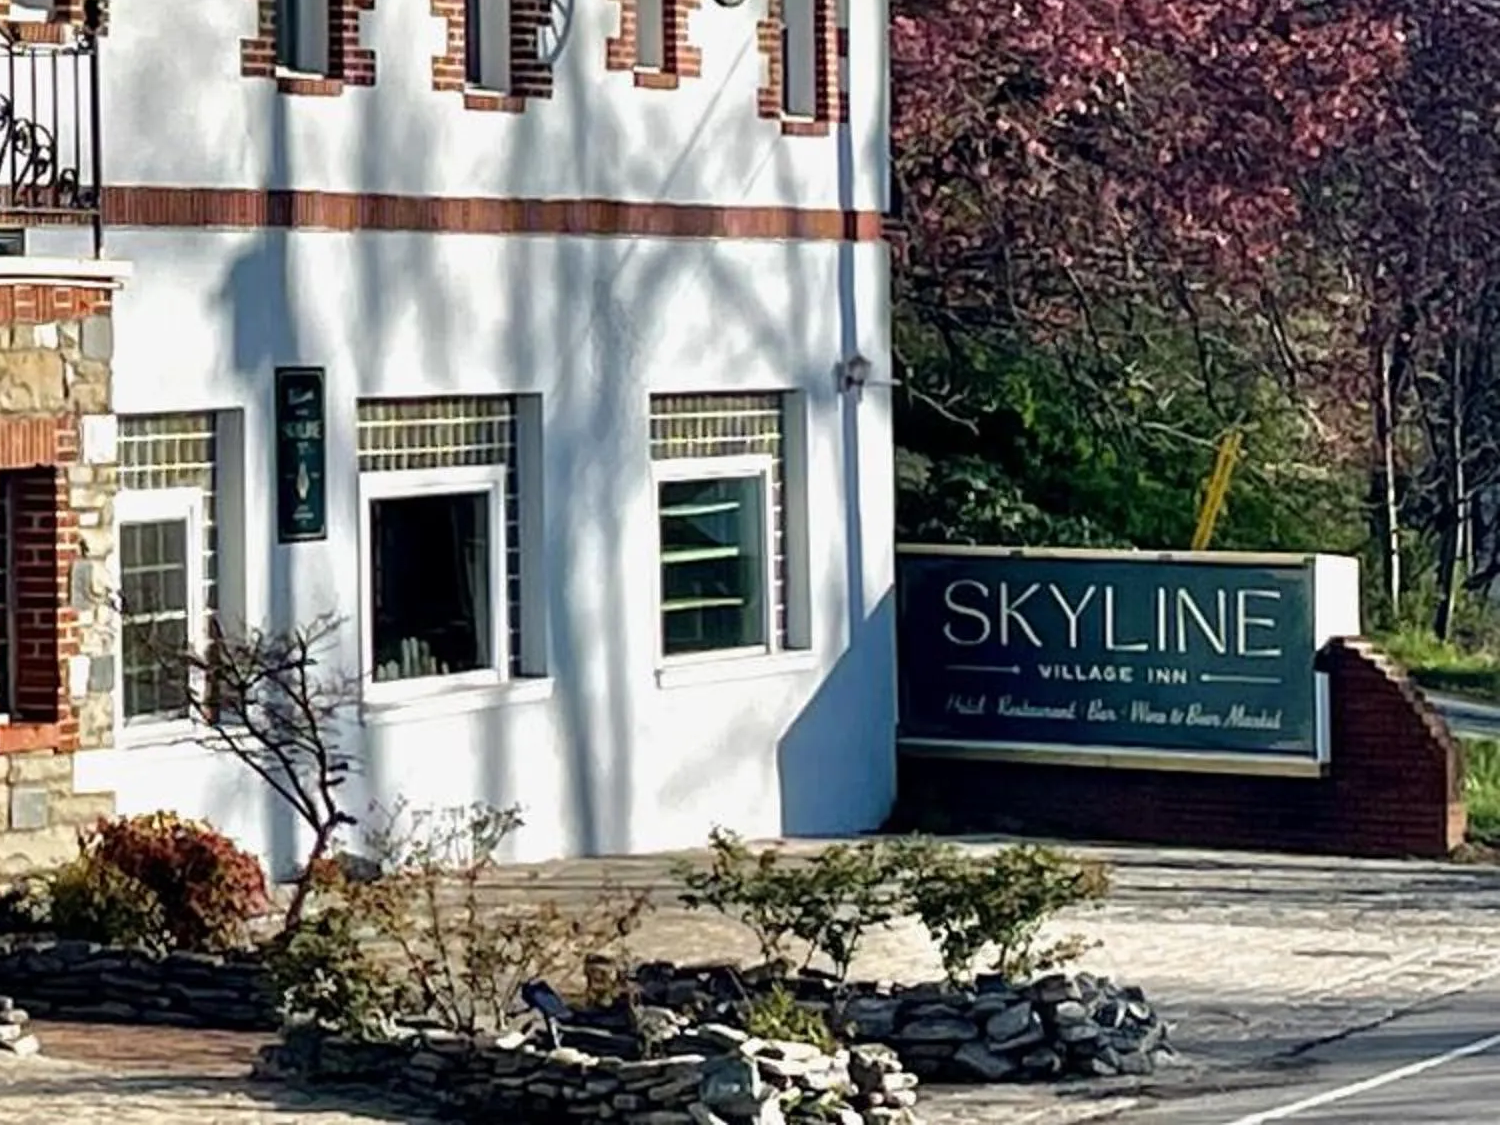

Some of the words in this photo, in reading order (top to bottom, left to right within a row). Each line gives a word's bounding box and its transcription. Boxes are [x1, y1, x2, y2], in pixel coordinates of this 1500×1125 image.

[942, 578, 1283, 657] SKYLINE
[1036, 664, 1134, 684] VILLAGE
[1147, 667, 1188, 685] INN
[997, 693, 1077, 721] Restaurant
